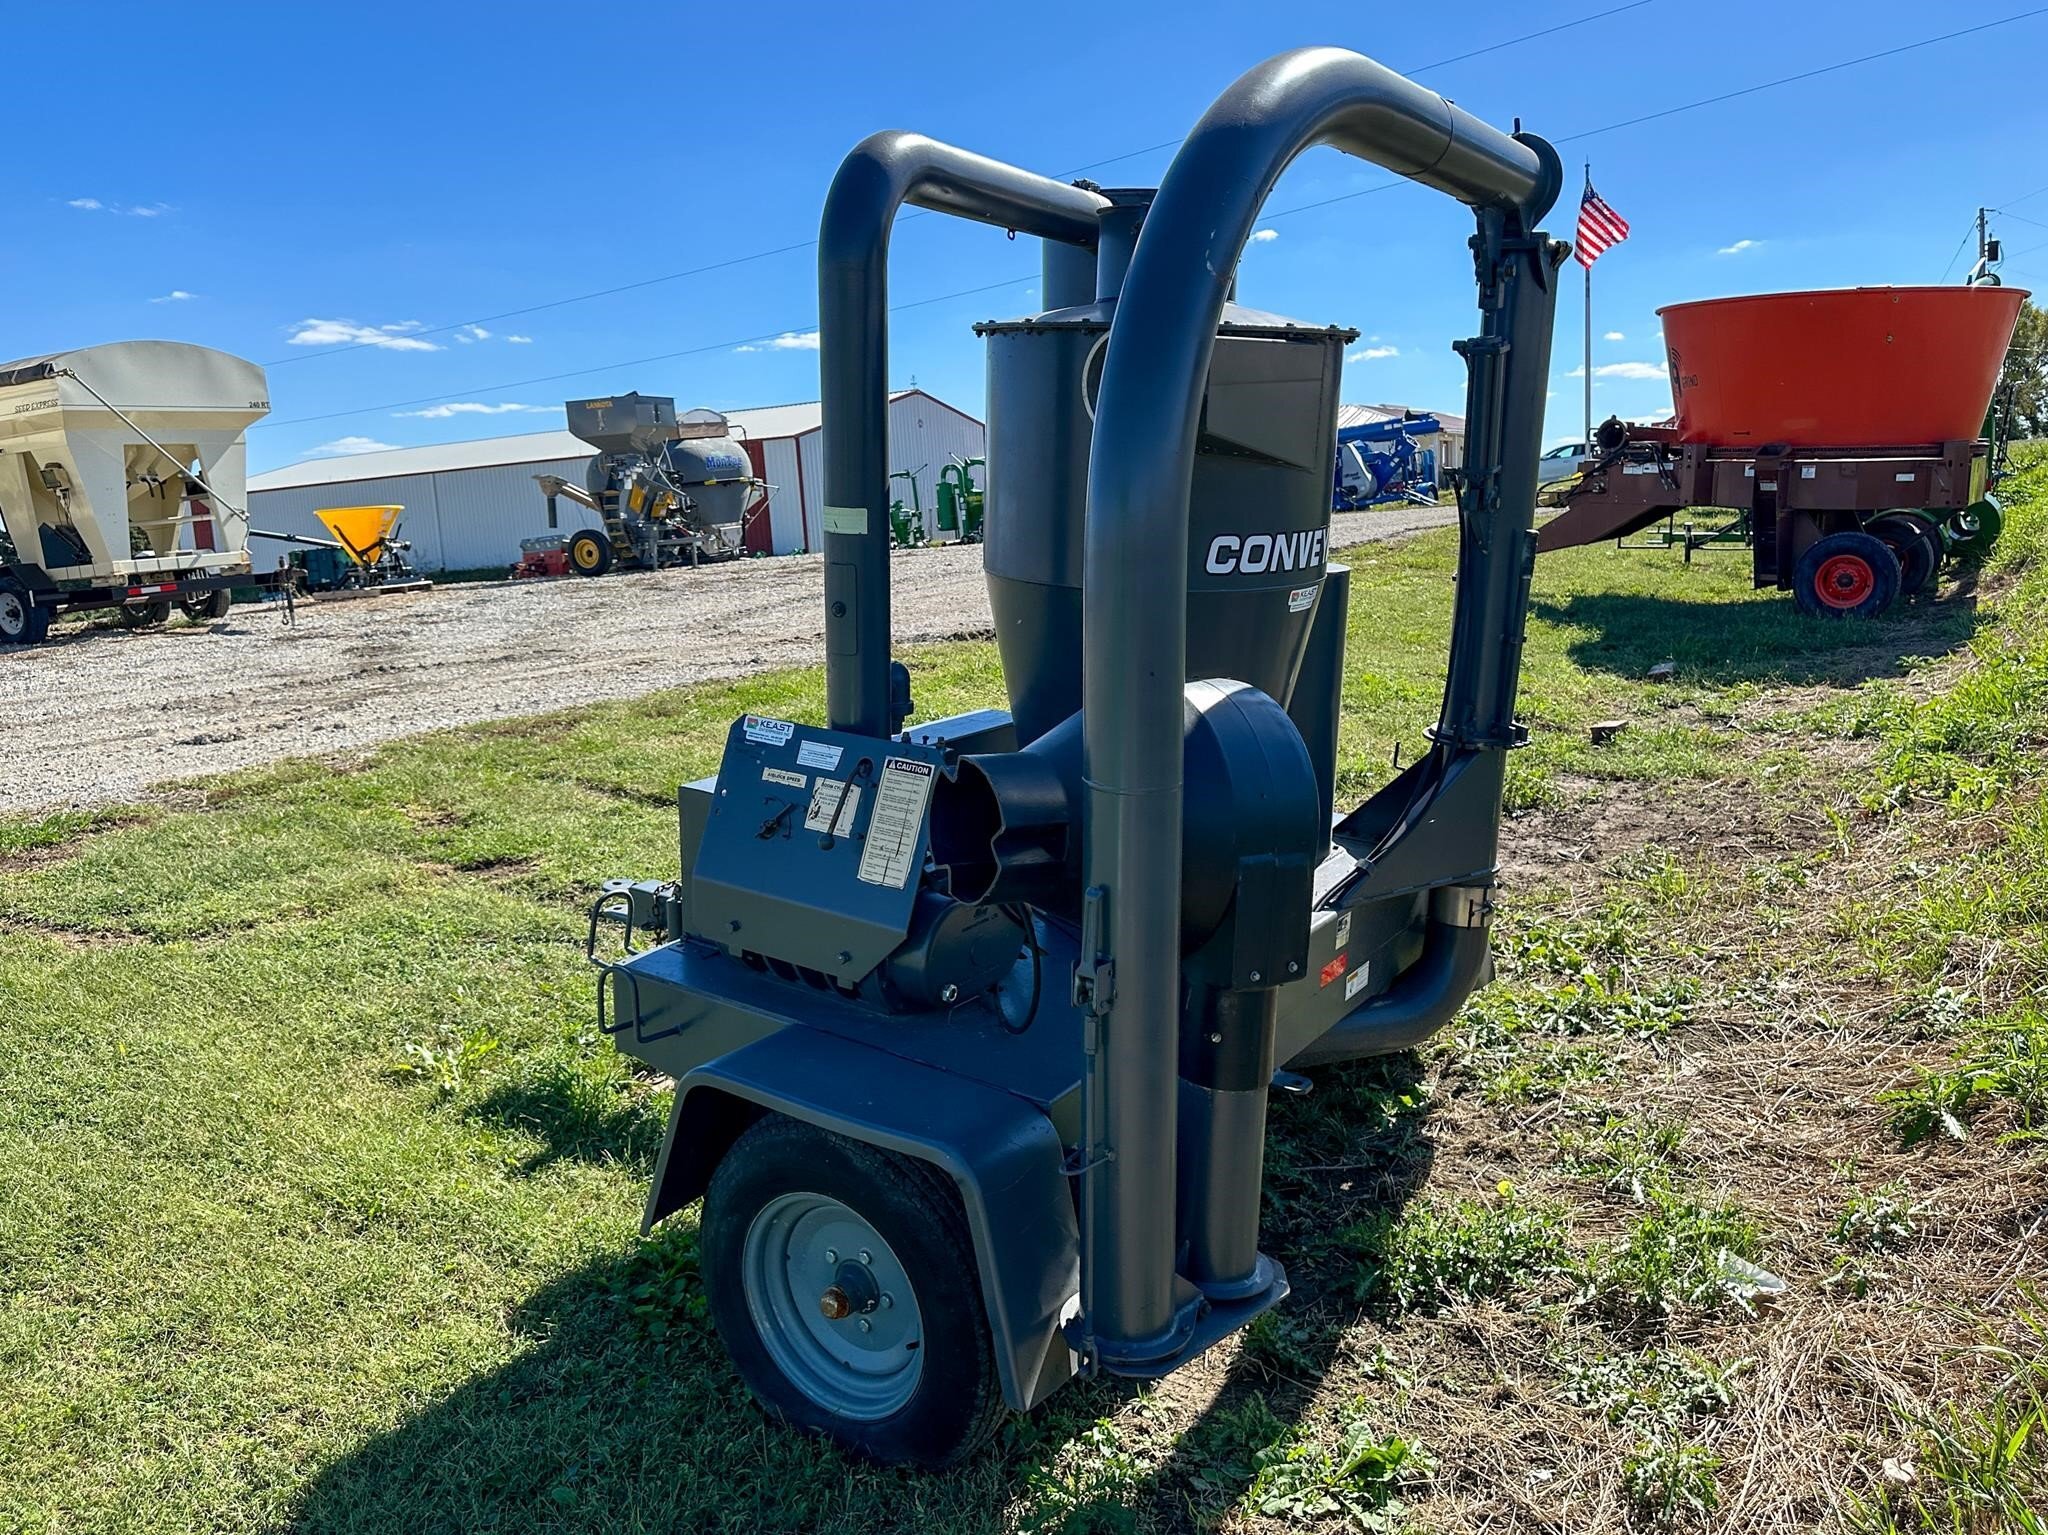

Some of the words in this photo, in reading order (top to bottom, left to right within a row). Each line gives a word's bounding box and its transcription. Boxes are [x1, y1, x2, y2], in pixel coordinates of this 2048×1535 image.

[14, 403, 31, 414] SEED
[31, 398, 59, 411] EXPRESS
[248, 401, 260, 409] 240
[759, 719, 793, 733] KEAST
[896, 762, 929, 775] CAUTION
[786, 775, 802, 784] SPEED
